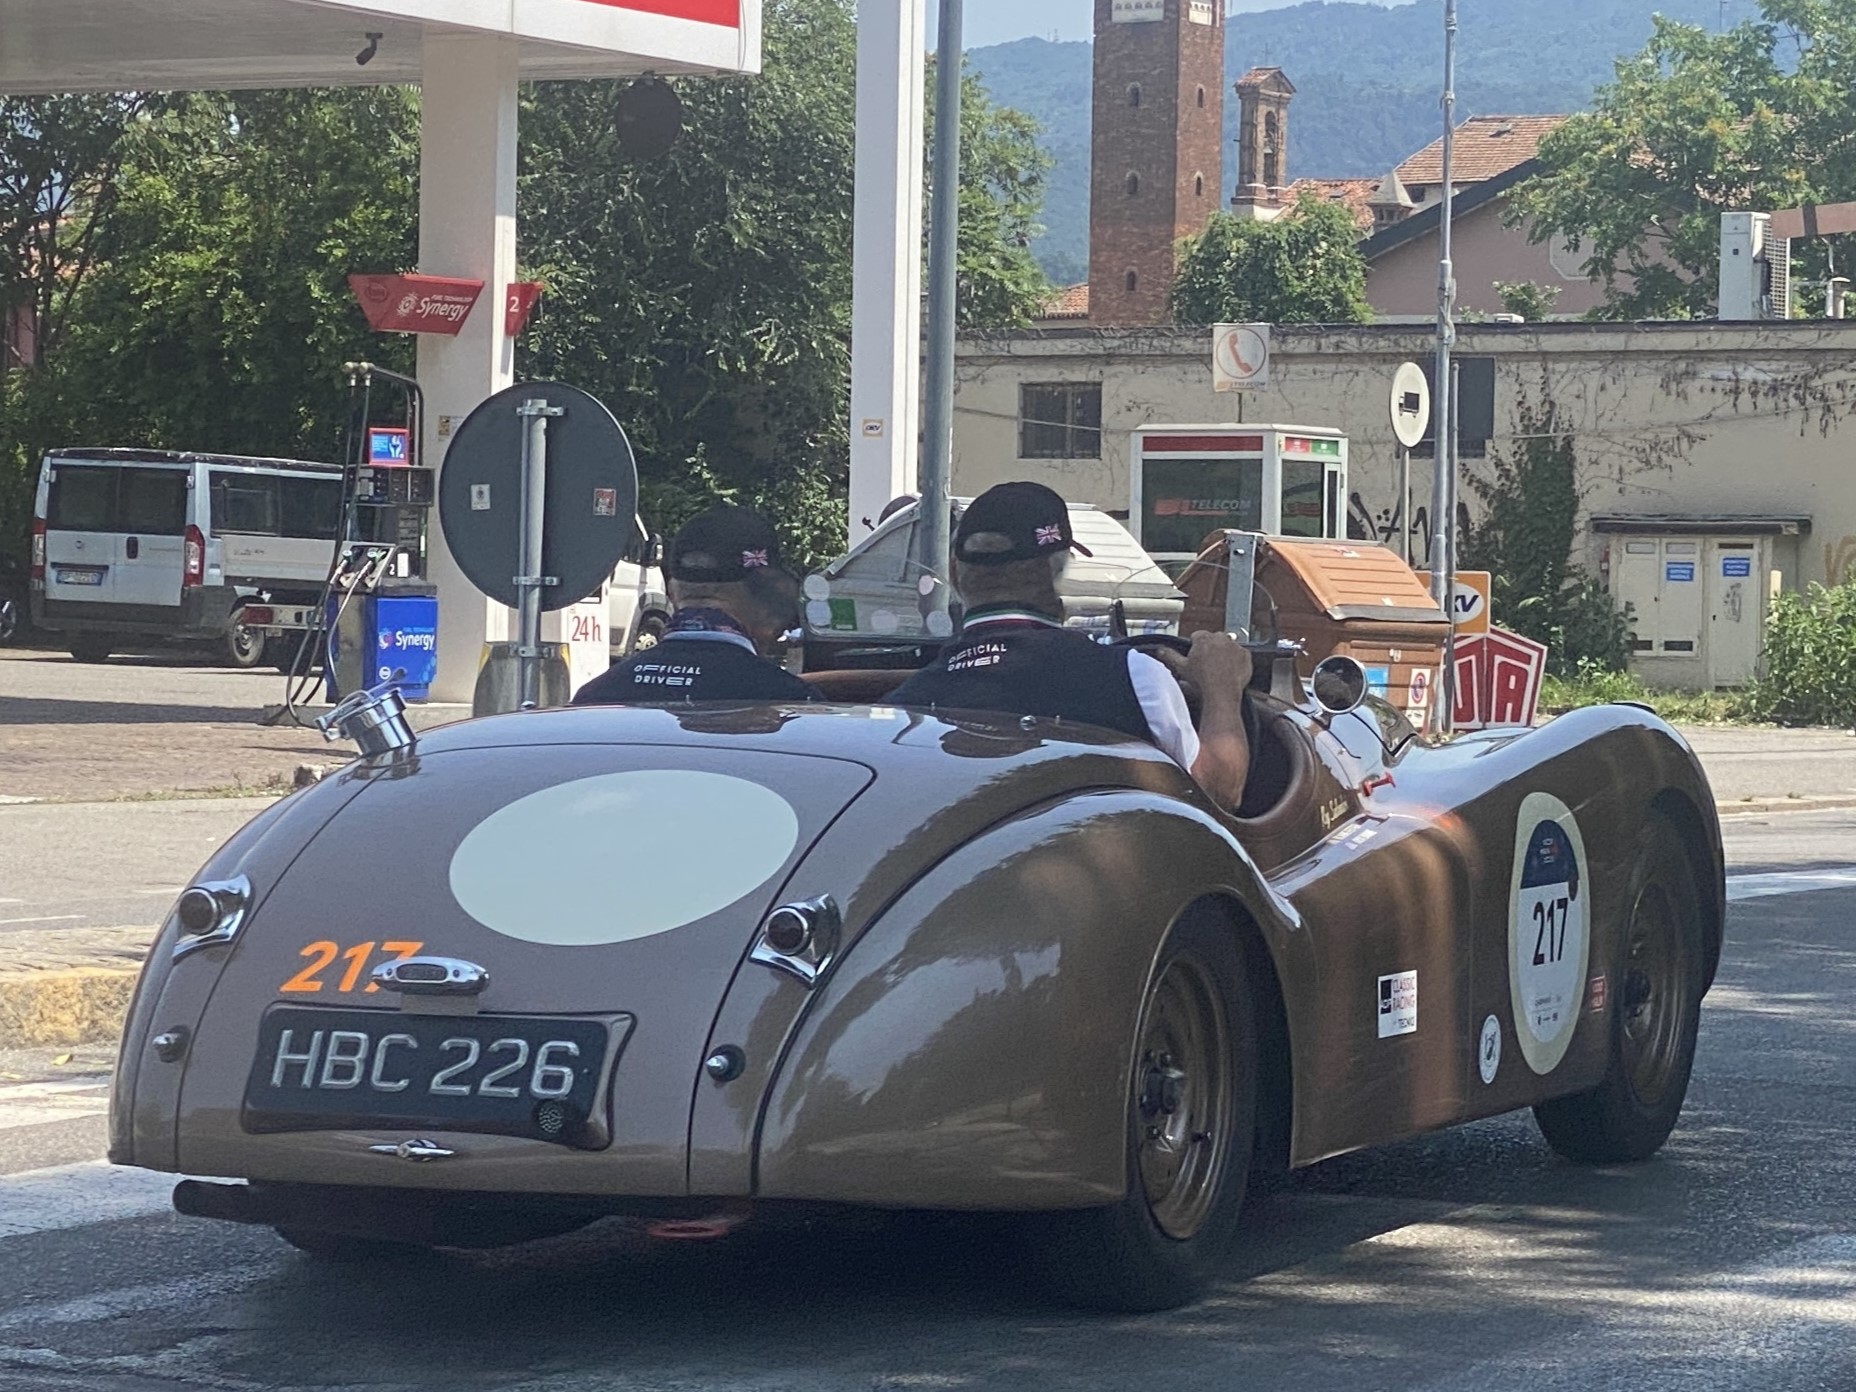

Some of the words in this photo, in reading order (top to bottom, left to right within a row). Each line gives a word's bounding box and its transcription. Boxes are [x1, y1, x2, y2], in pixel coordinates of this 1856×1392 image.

[416, 297, 469, 321] Synergy
[509, 296, 519, 312] 2
[1445, 594, 1479, 613] KV
[395, 630, 435, 651] Synergy
[633, 664, 701, 675] OFFICIAL
[947, 655, 1000, 672] DRIVER
[634, 675, 693, 686] DRIVER
[1532, 897, 1569, 966] 217
[269, 1029, 418, 1092] HBC
[430, 1037, 580, 1099] 226
